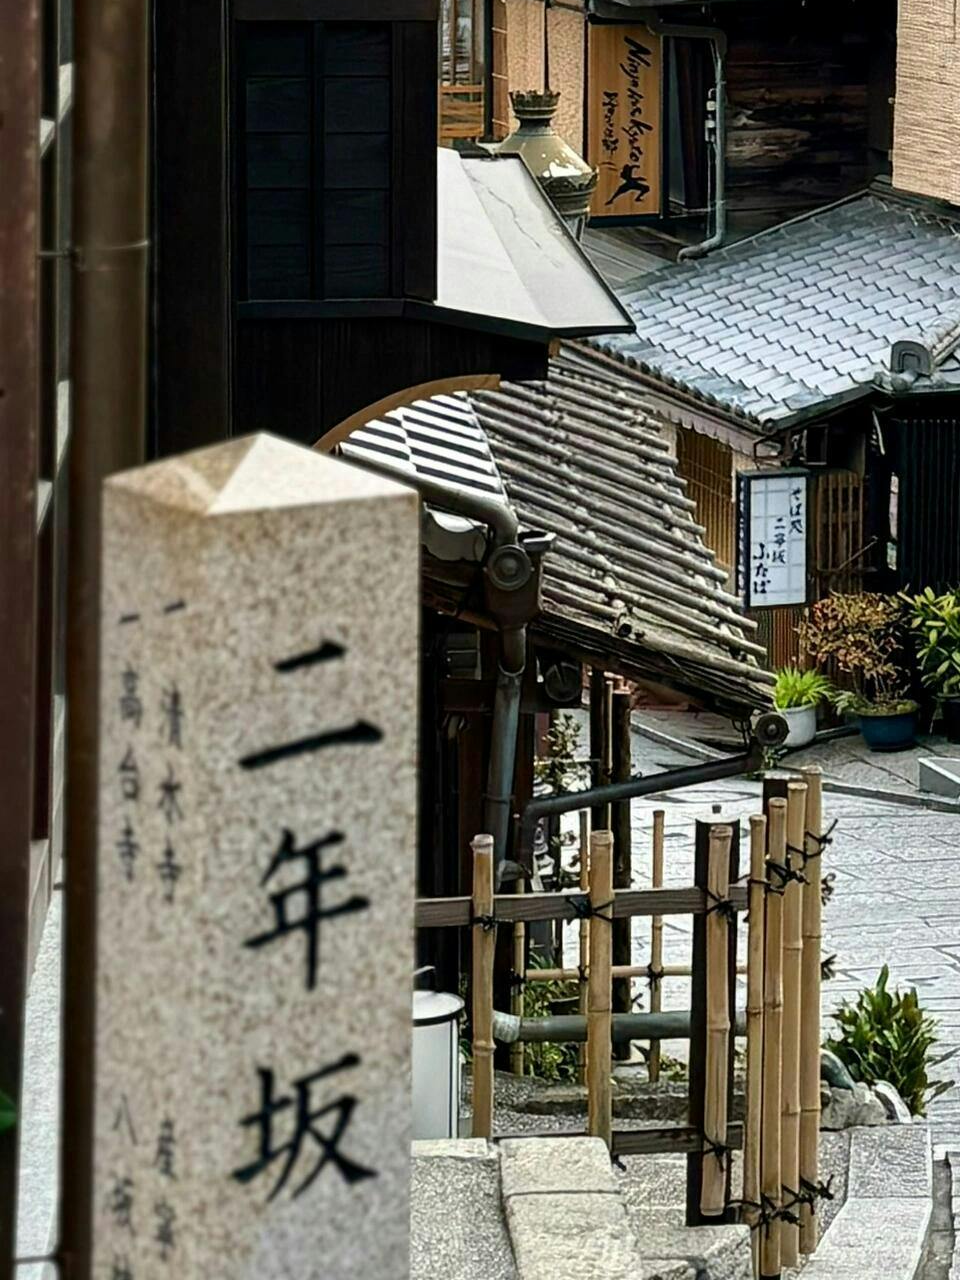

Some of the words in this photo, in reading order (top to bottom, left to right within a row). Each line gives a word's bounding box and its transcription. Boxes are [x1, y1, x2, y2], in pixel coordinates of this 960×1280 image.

[622, 119, 653, 163] Kyoto
[752, 543, 771, 594] ふたば
[115, 660, 143, 883] 高台寺
[231, 638, 386, 1203] 二年坂
